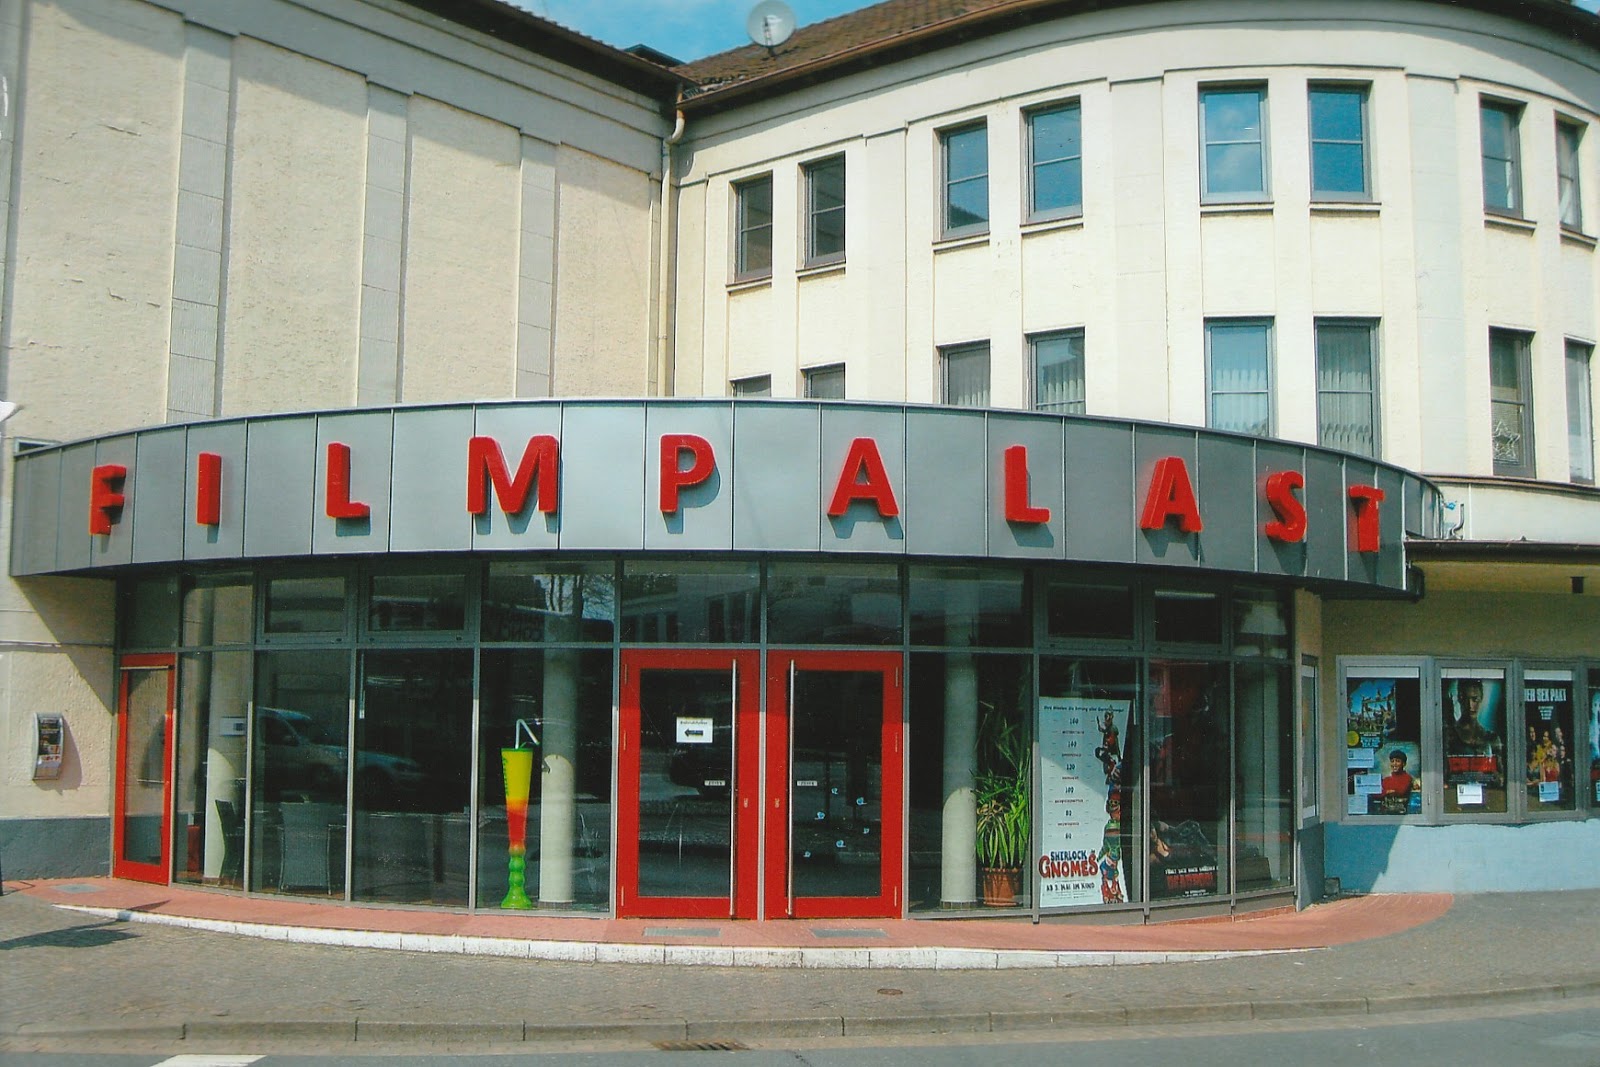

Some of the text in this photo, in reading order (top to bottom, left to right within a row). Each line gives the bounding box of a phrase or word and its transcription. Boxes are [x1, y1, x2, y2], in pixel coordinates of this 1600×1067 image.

[90, 434, 1385, 555] FILMPALAST
[1038, 852, 1098, 878] GNOMES
[1050, 850, 1087, 861] SHERLOCK
